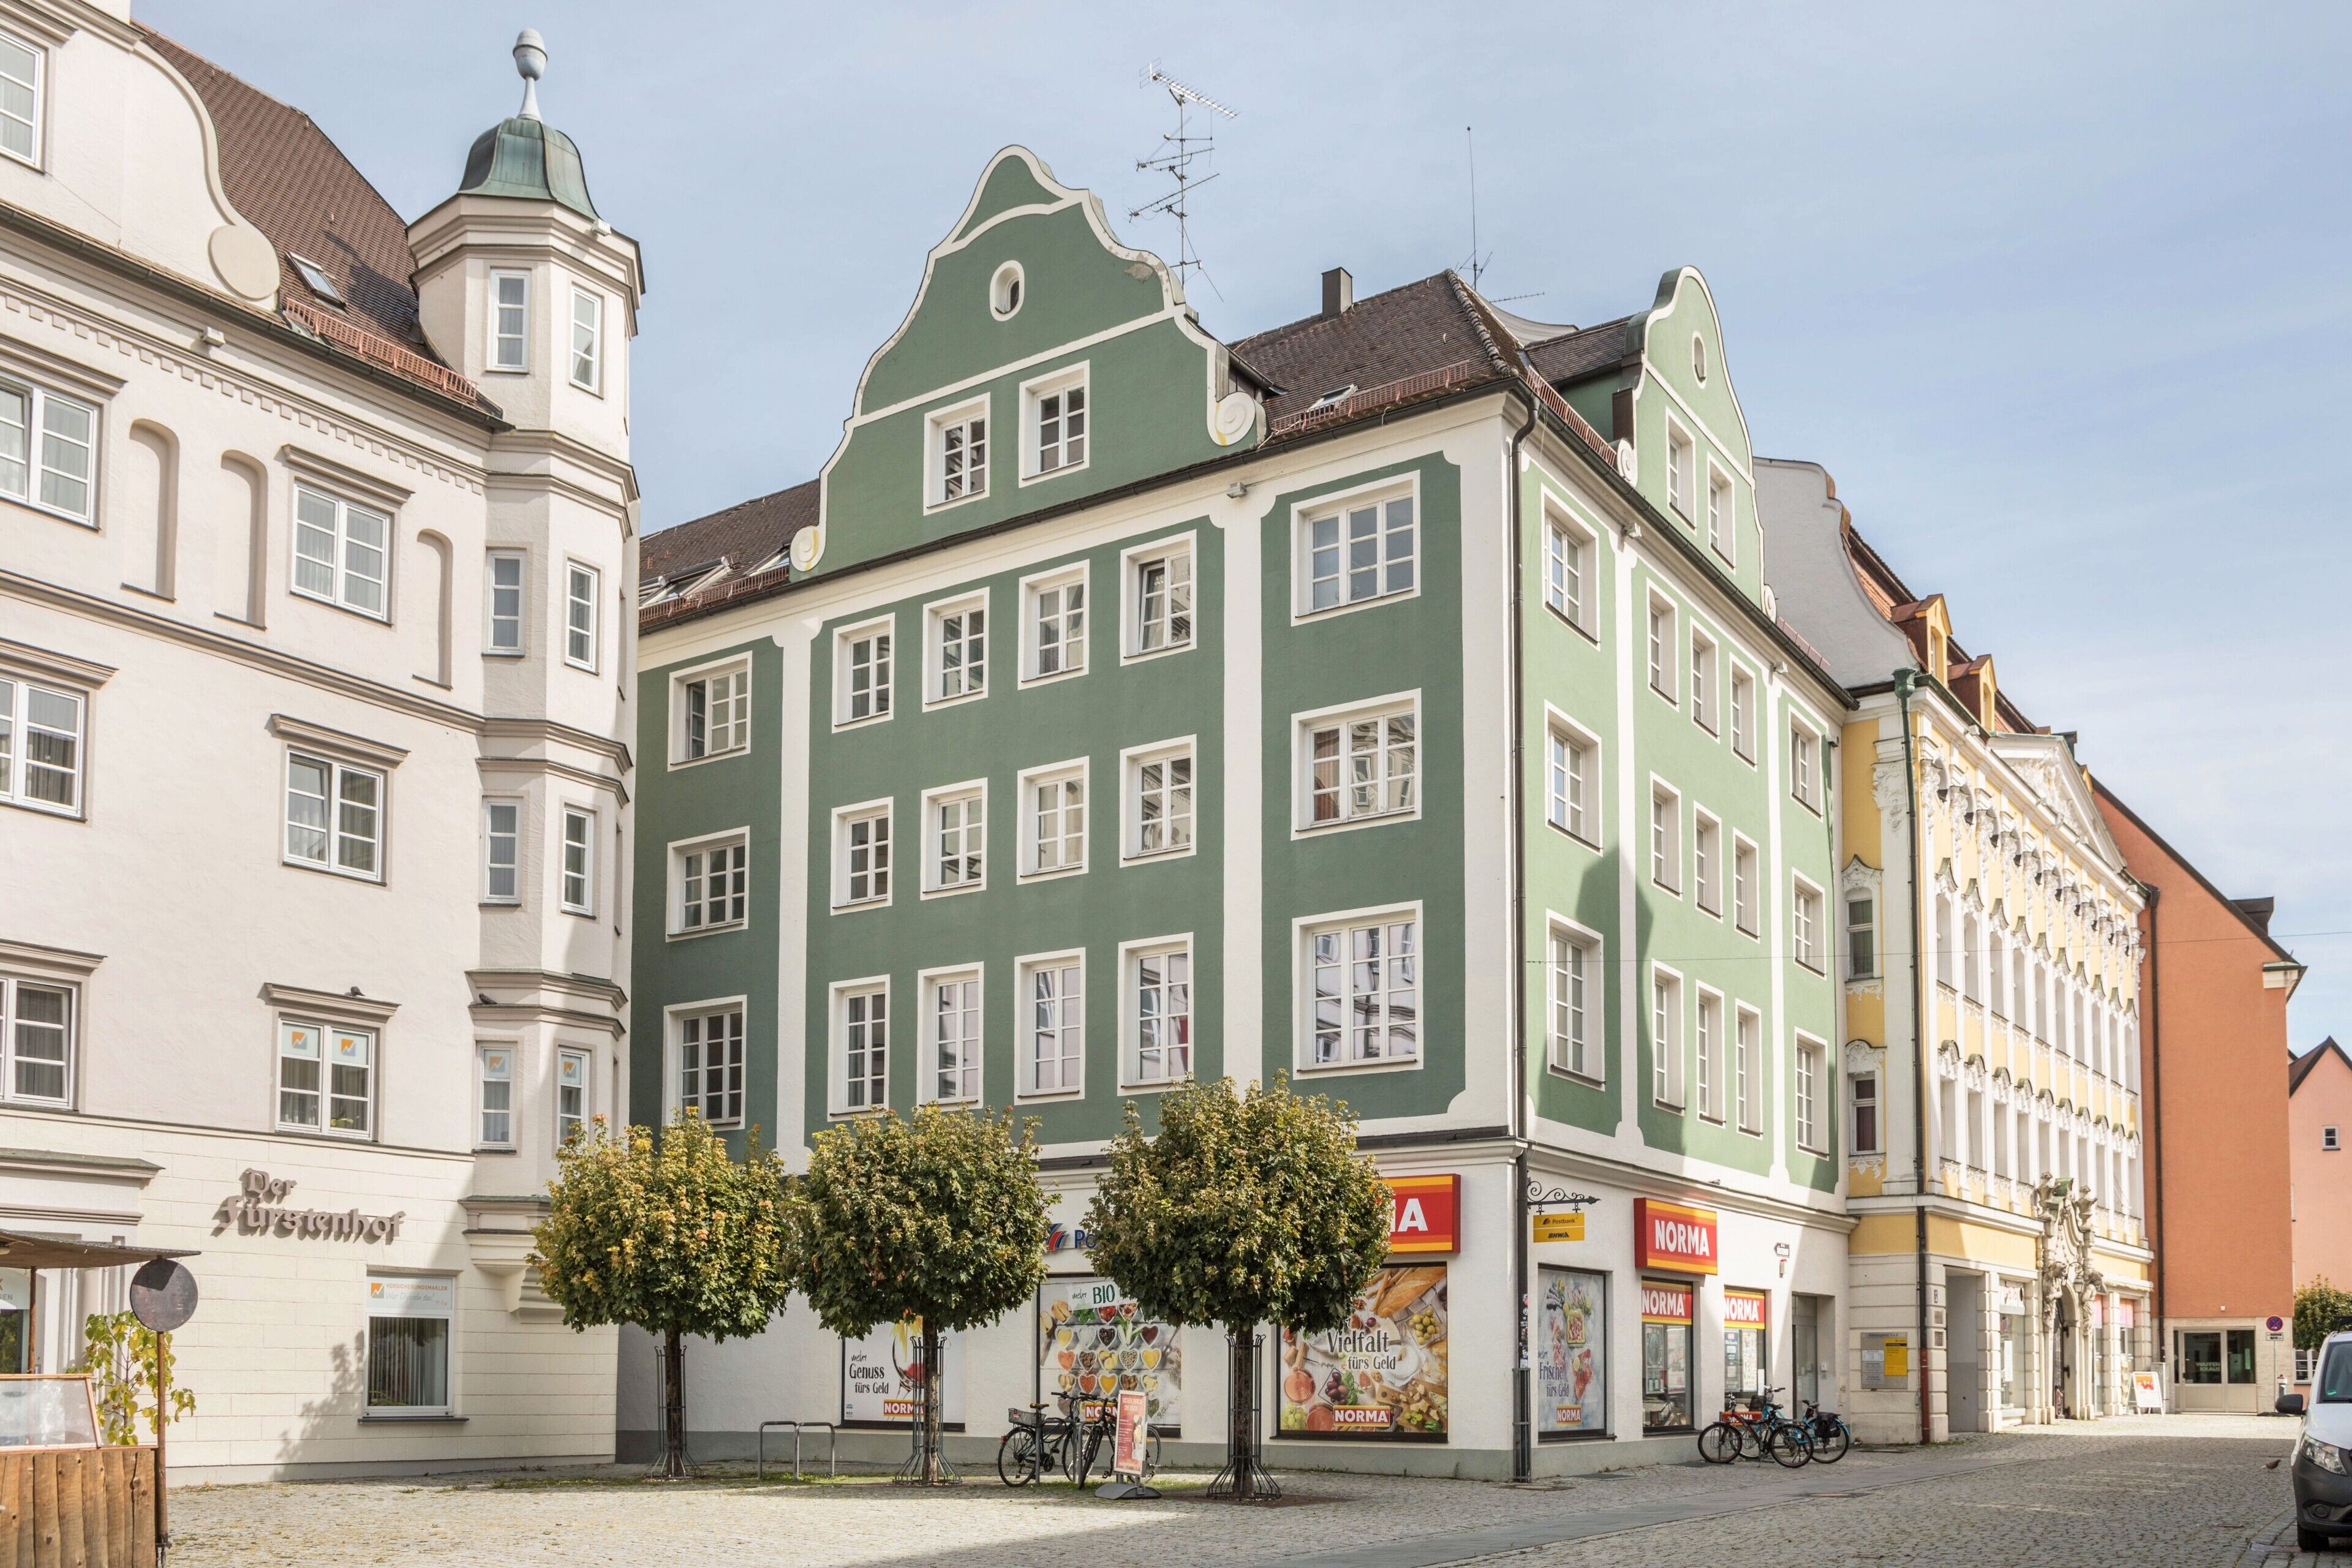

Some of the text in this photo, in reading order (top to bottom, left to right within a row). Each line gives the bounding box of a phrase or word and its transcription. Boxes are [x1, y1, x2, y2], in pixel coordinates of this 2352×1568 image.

[241, 1167, 298, 1196] Der
[214, 1194, 407, 1237] Fürstenhof
[1654, 1219, 1710, 1257] NORMA
[386, 1283, 448, 1292] VERSICHERUNGSMAKLER
[1072, 1284, 1115, 1305] mehr BIO
[1642, 1290, 1685, 1316] NORMA
[1724, 1297, 1759, 1321] NORMA
[1327, 1330, 1390, 1353] Vielfalt
[851, 1350, 867, 1362] mehr
[1348, 1355, 1396, 1370] fürs Geld
[849, 1363, 885, 1379] Genuss
[1539, 1361, 1563, 1381] Frische
[854, 1382, 889, 1394] fürs Geld
[1547, 1383, 1569, 1397] fürs Geld
[1334, 1409, 1389, 1423] NORMA
[1556, 1409, 1581, 1422] NORMA
